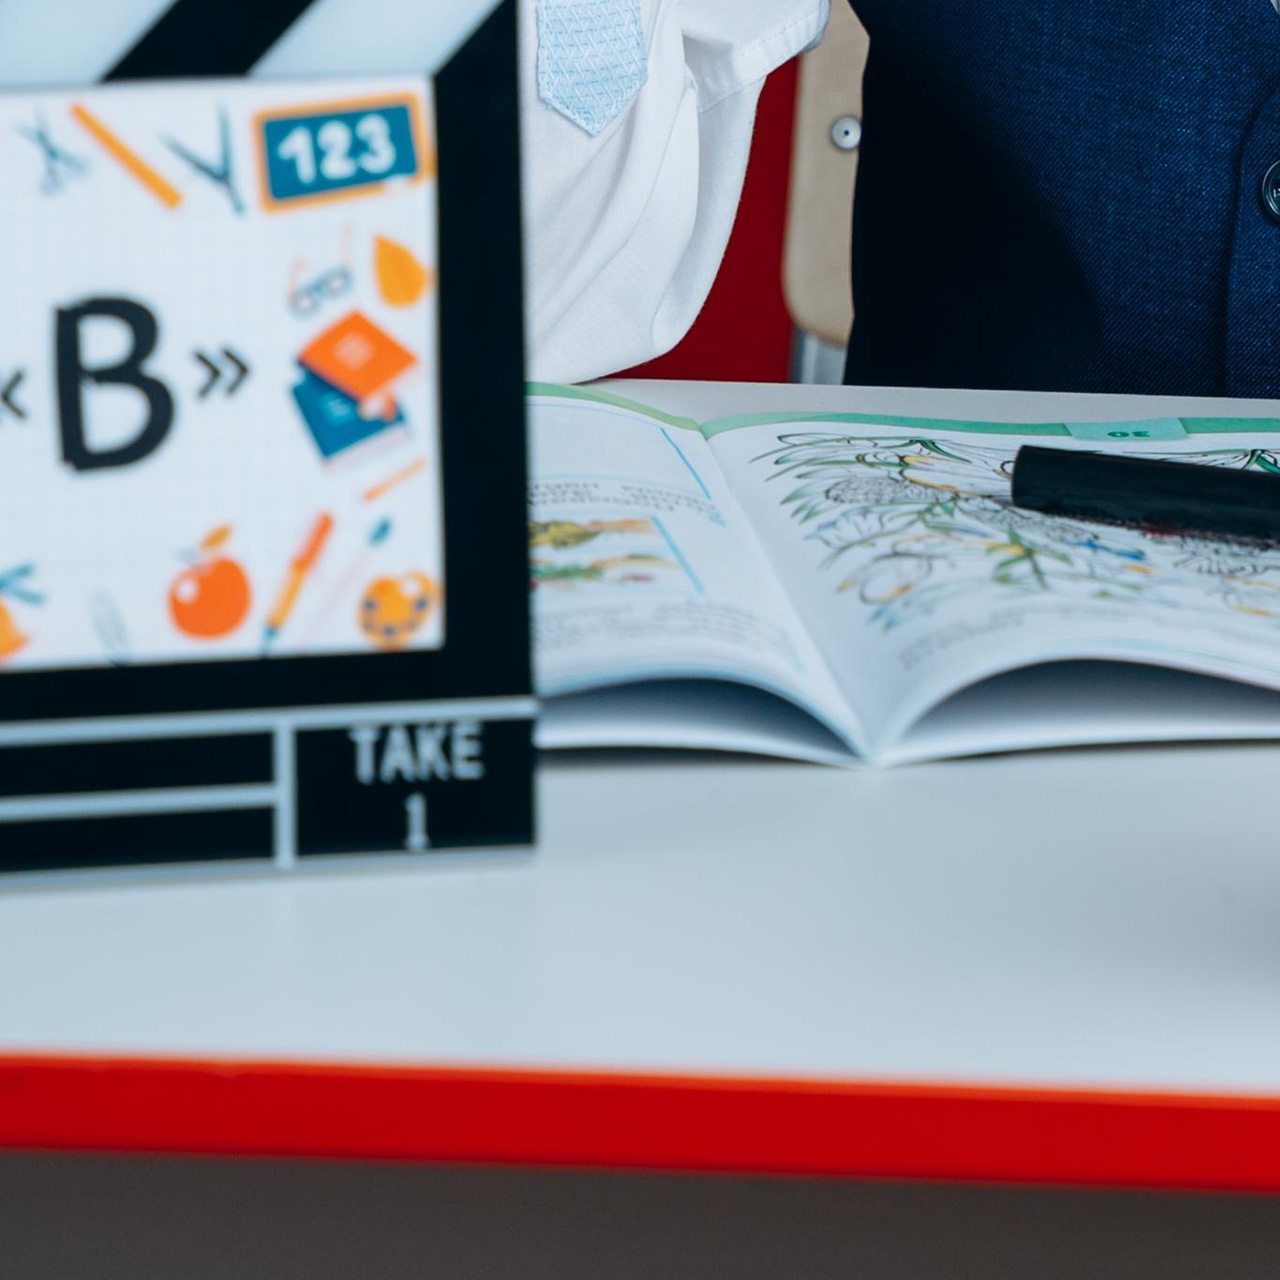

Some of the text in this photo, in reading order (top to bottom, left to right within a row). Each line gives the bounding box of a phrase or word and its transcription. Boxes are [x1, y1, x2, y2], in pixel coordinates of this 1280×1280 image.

[277, 112, 397, 185] 123
[348, 718, 486, 787] TAKE
[404, 792, 432, 852] 1
